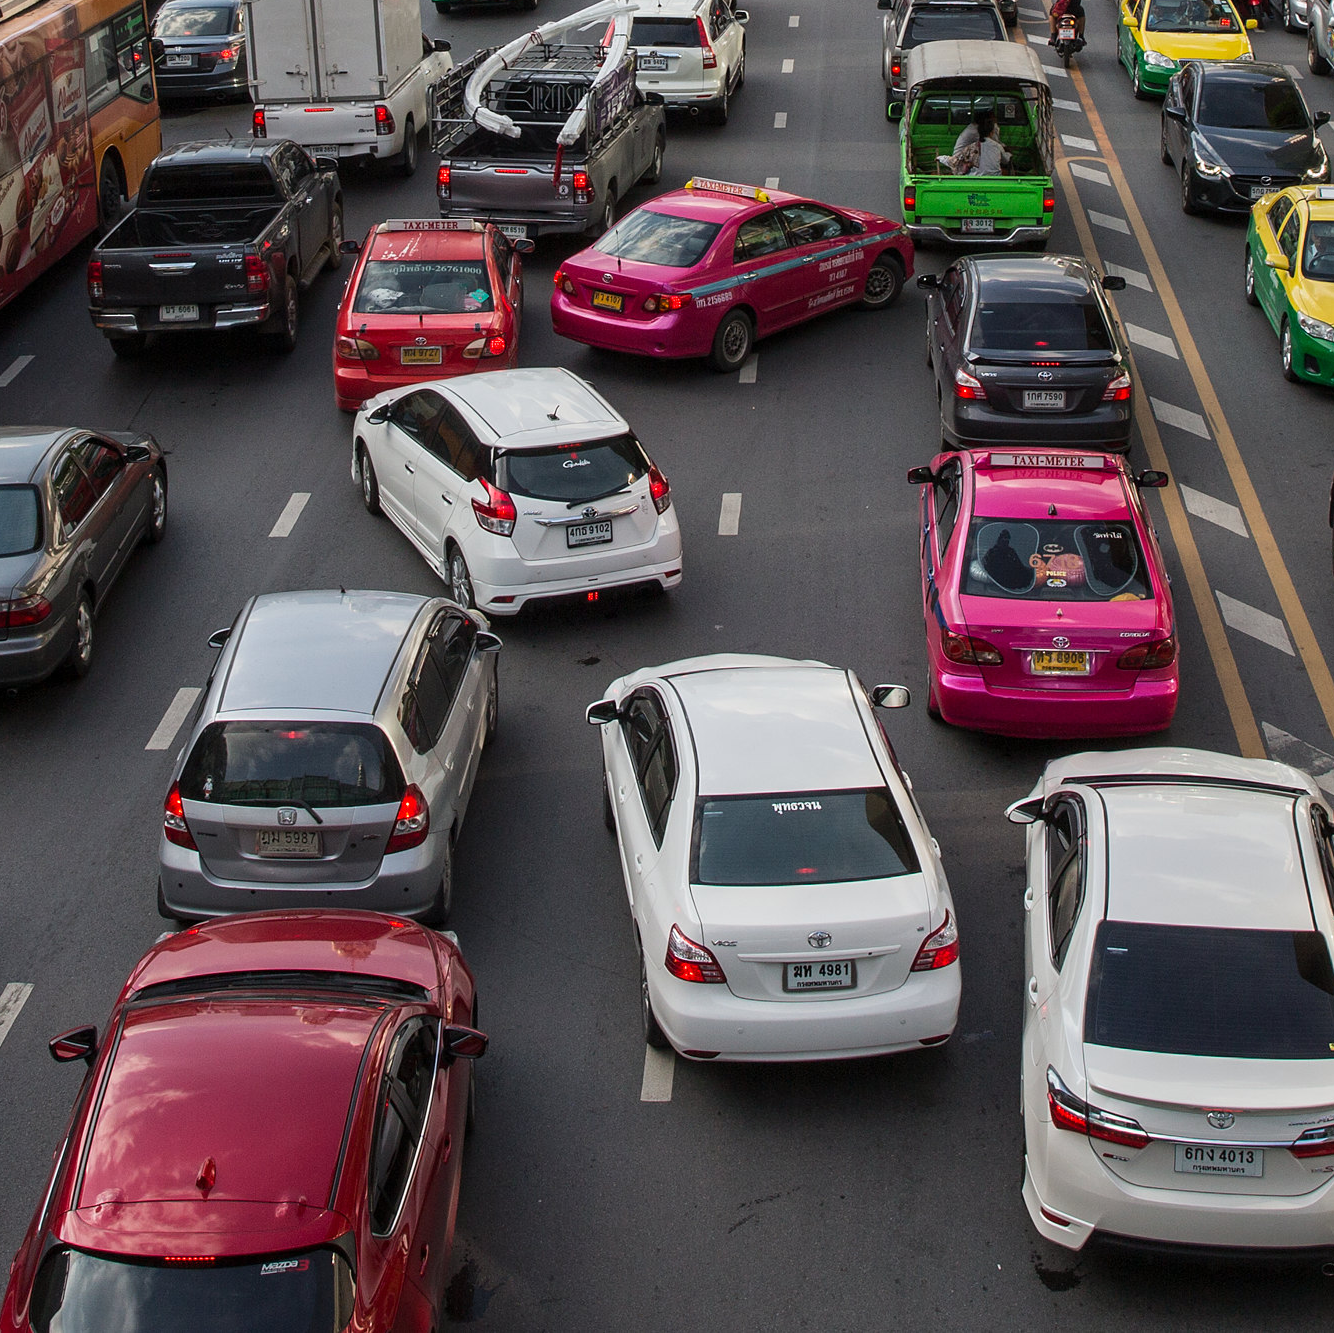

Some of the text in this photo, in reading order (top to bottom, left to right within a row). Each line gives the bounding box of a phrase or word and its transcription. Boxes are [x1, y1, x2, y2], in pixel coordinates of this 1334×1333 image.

[700, 179, 743, 195] TAXI-METER
[403, 221, 459, 230] TAXI-METER
[1044, 392, 1063, 401] 7590
[1012, 455, 1085, 467] TAXI-METER
[589, 523, 610, 536] 9102
[1056, 653, 1085, 664] 8906
[771, 800, 822, 815] พุทธวจน
[285, 831, 316, 844] 5987
[818, 963, 849, 977] 4981
[1218, 1149, 1255, 1164] 4013
[261, 1260, 298, 1271] MAZDA
